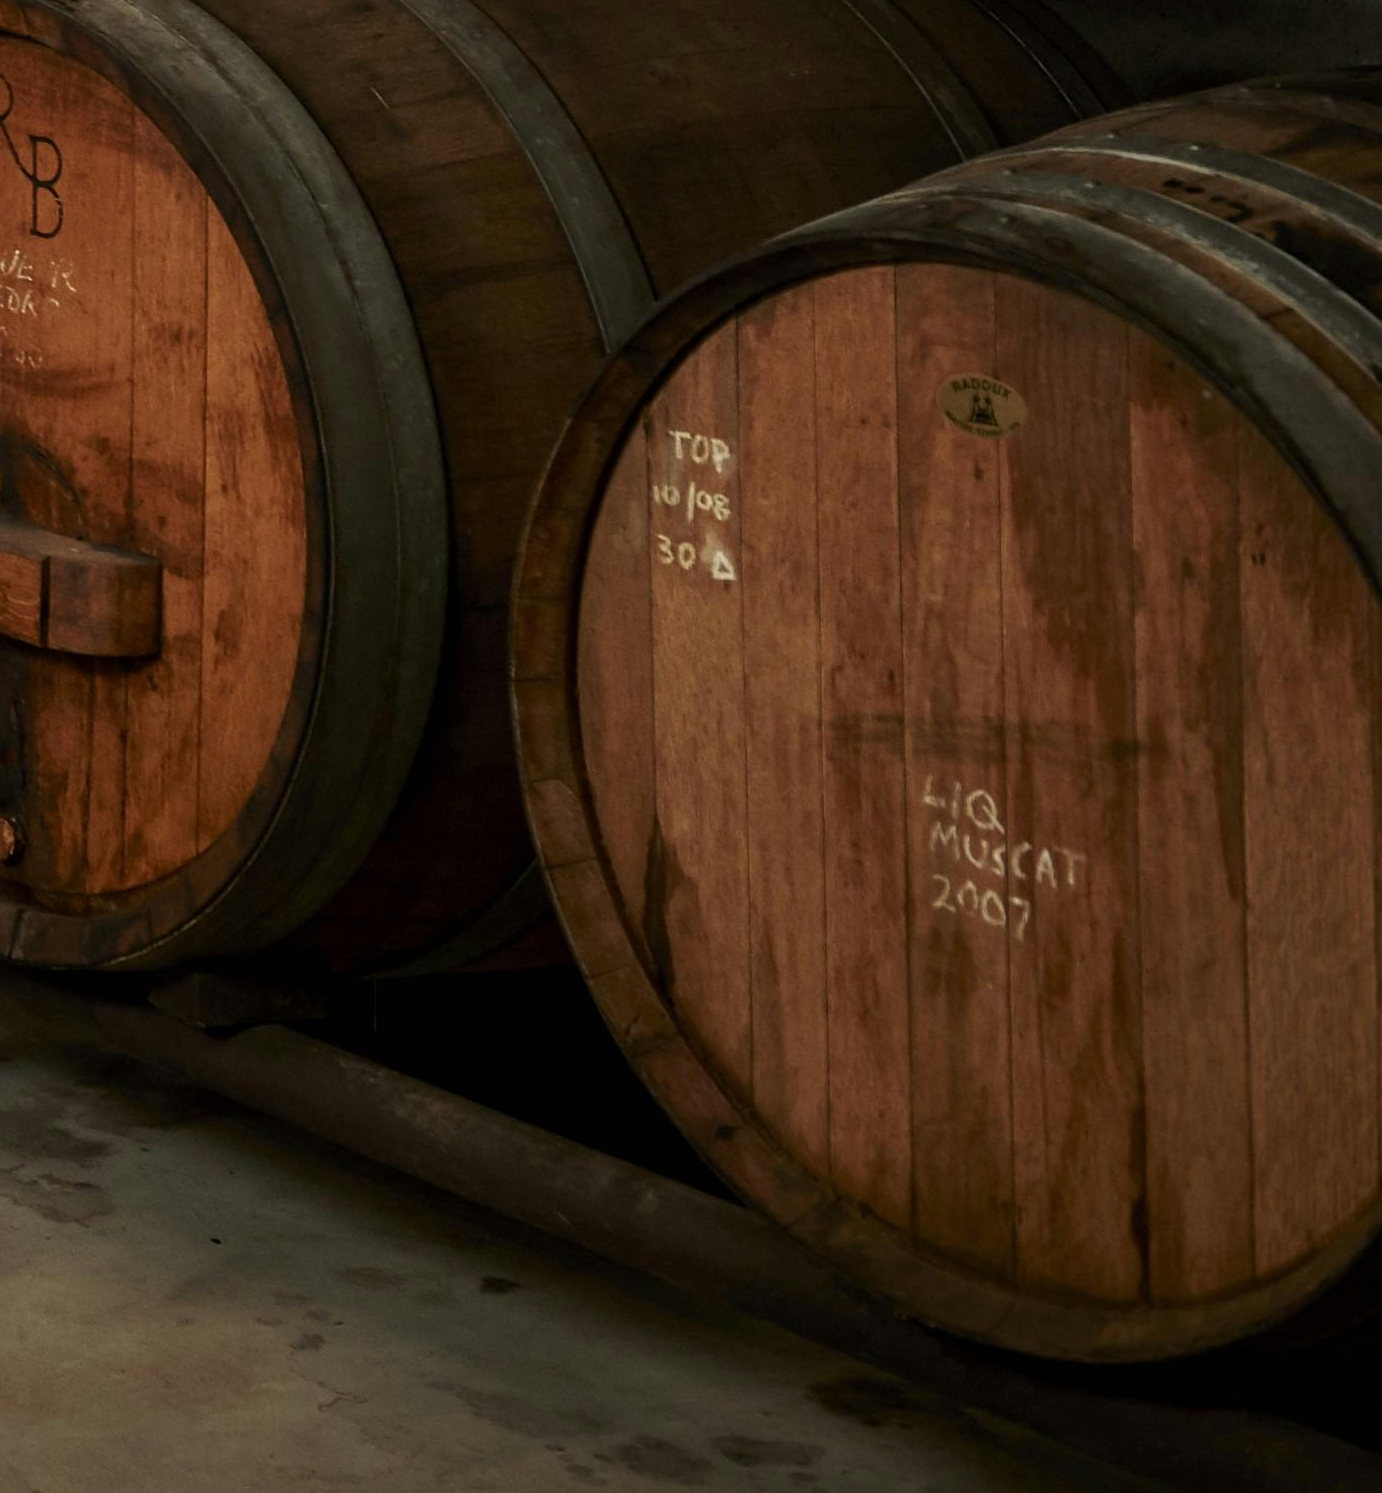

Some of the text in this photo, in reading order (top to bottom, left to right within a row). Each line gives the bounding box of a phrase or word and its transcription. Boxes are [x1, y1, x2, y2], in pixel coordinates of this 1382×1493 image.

[668, 429, 731, 475] TOP
[922, 774, 1007, 835] LIQ
[930, 821, 1088, 889] MUSCAT
[930, 873, 1032, 942] 2007
